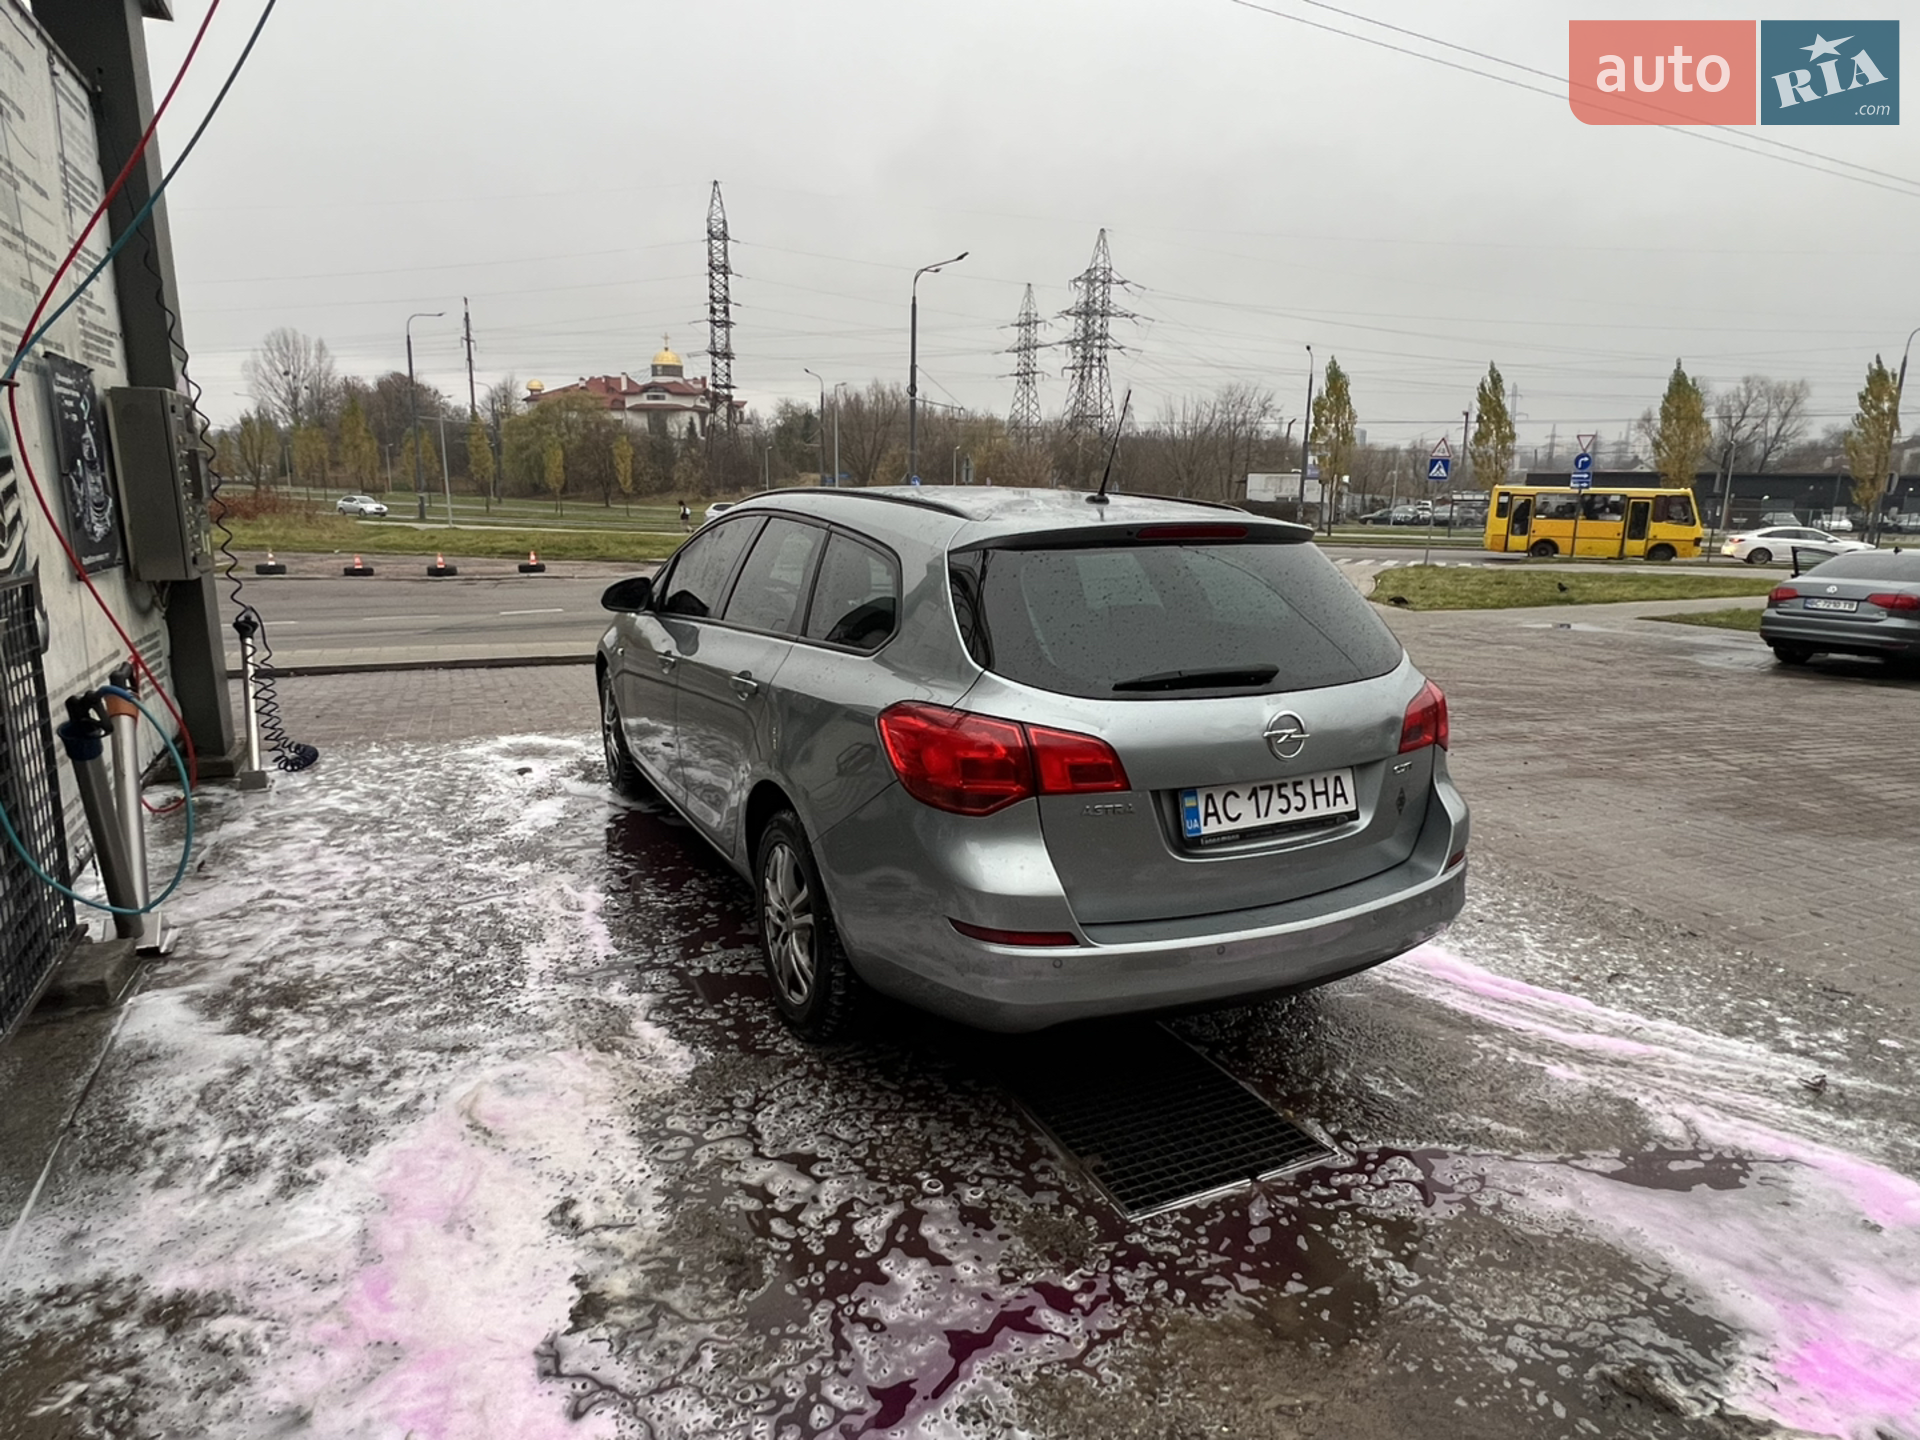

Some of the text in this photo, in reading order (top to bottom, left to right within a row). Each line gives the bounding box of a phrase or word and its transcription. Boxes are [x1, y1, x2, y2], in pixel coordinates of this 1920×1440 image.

[1203, 790, 1243, 827] AC
[1247, 779, 1307, 819] 1755
[1310, 775, 1349, 810] HA
[1083, 803, 1135, 816] ASTRA
[1186, 818, 1200, 830] UA
